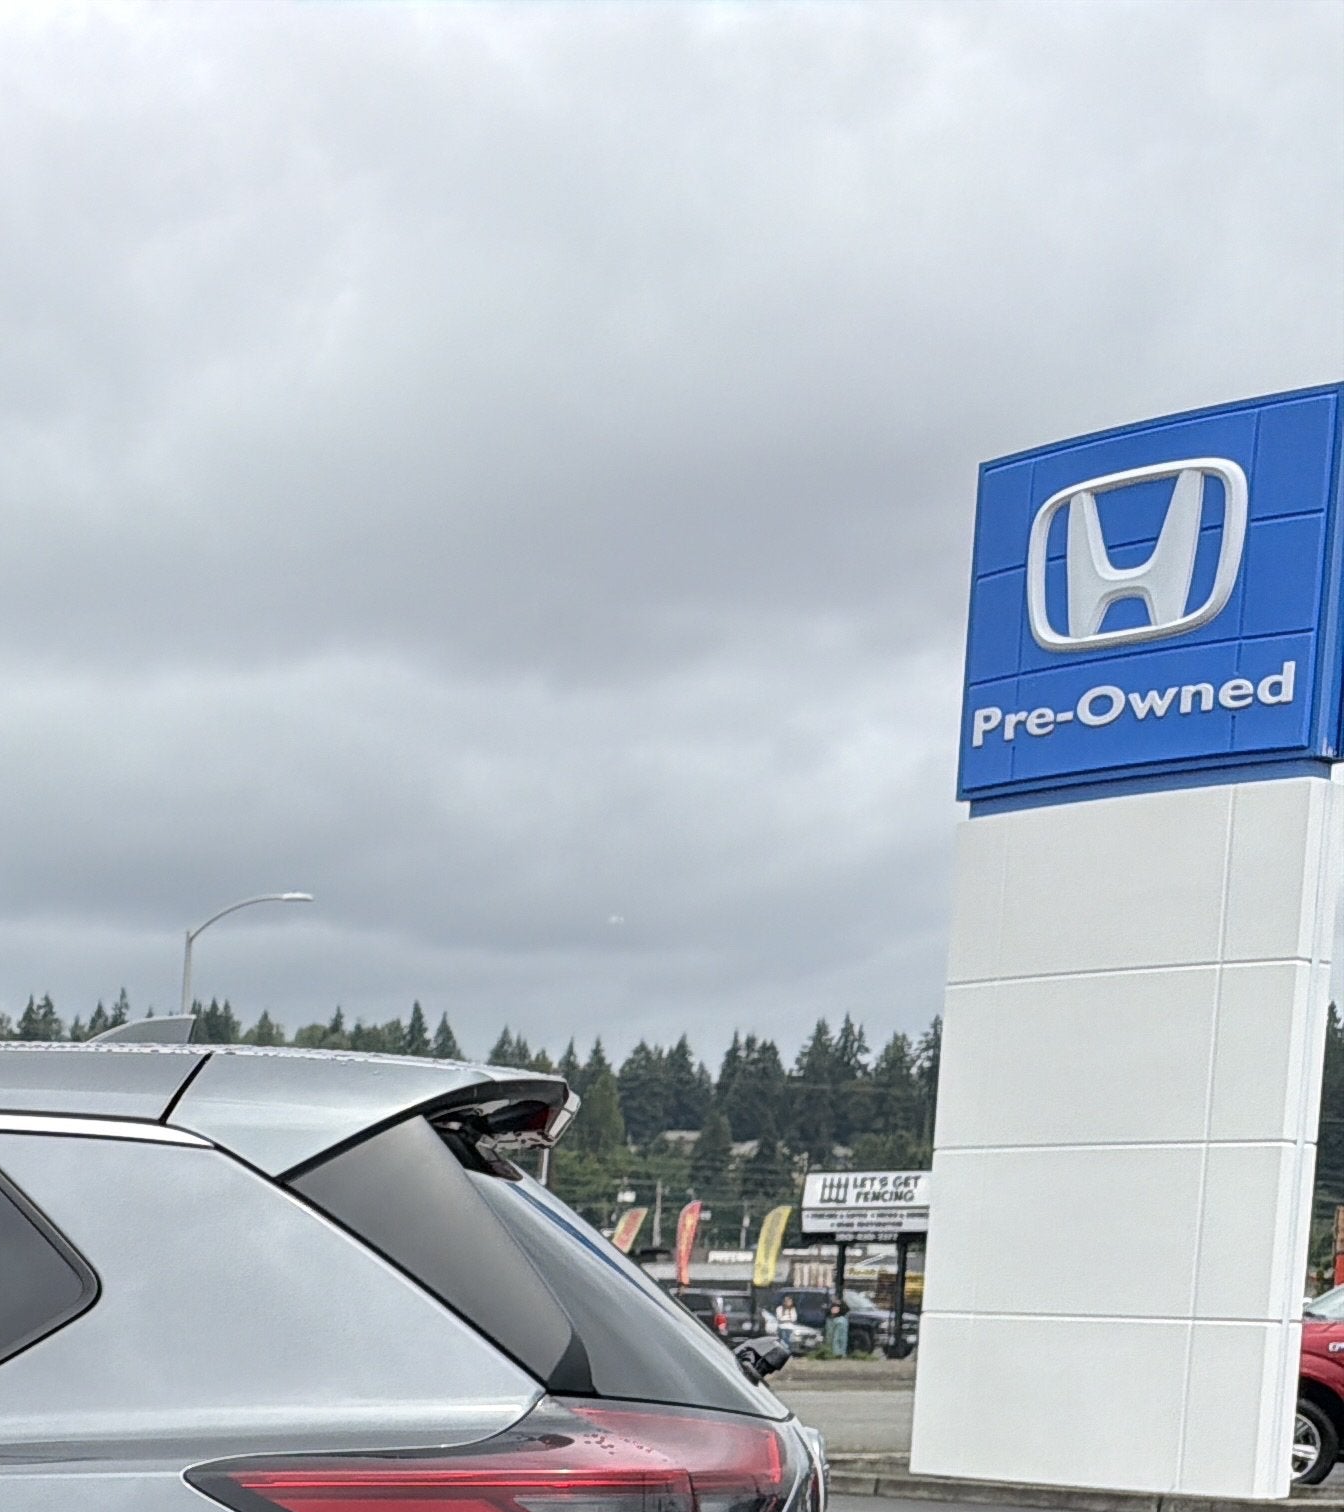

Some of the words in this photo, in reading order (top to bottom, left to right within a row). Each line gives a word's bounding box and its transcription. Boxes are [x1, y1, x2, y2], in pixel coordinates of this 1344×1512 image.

[971, 660, 1297, 748] Pre-Owned
[892, 1175, 922, 1189] GET
[855, 1189, 915, 1203] FENCING
